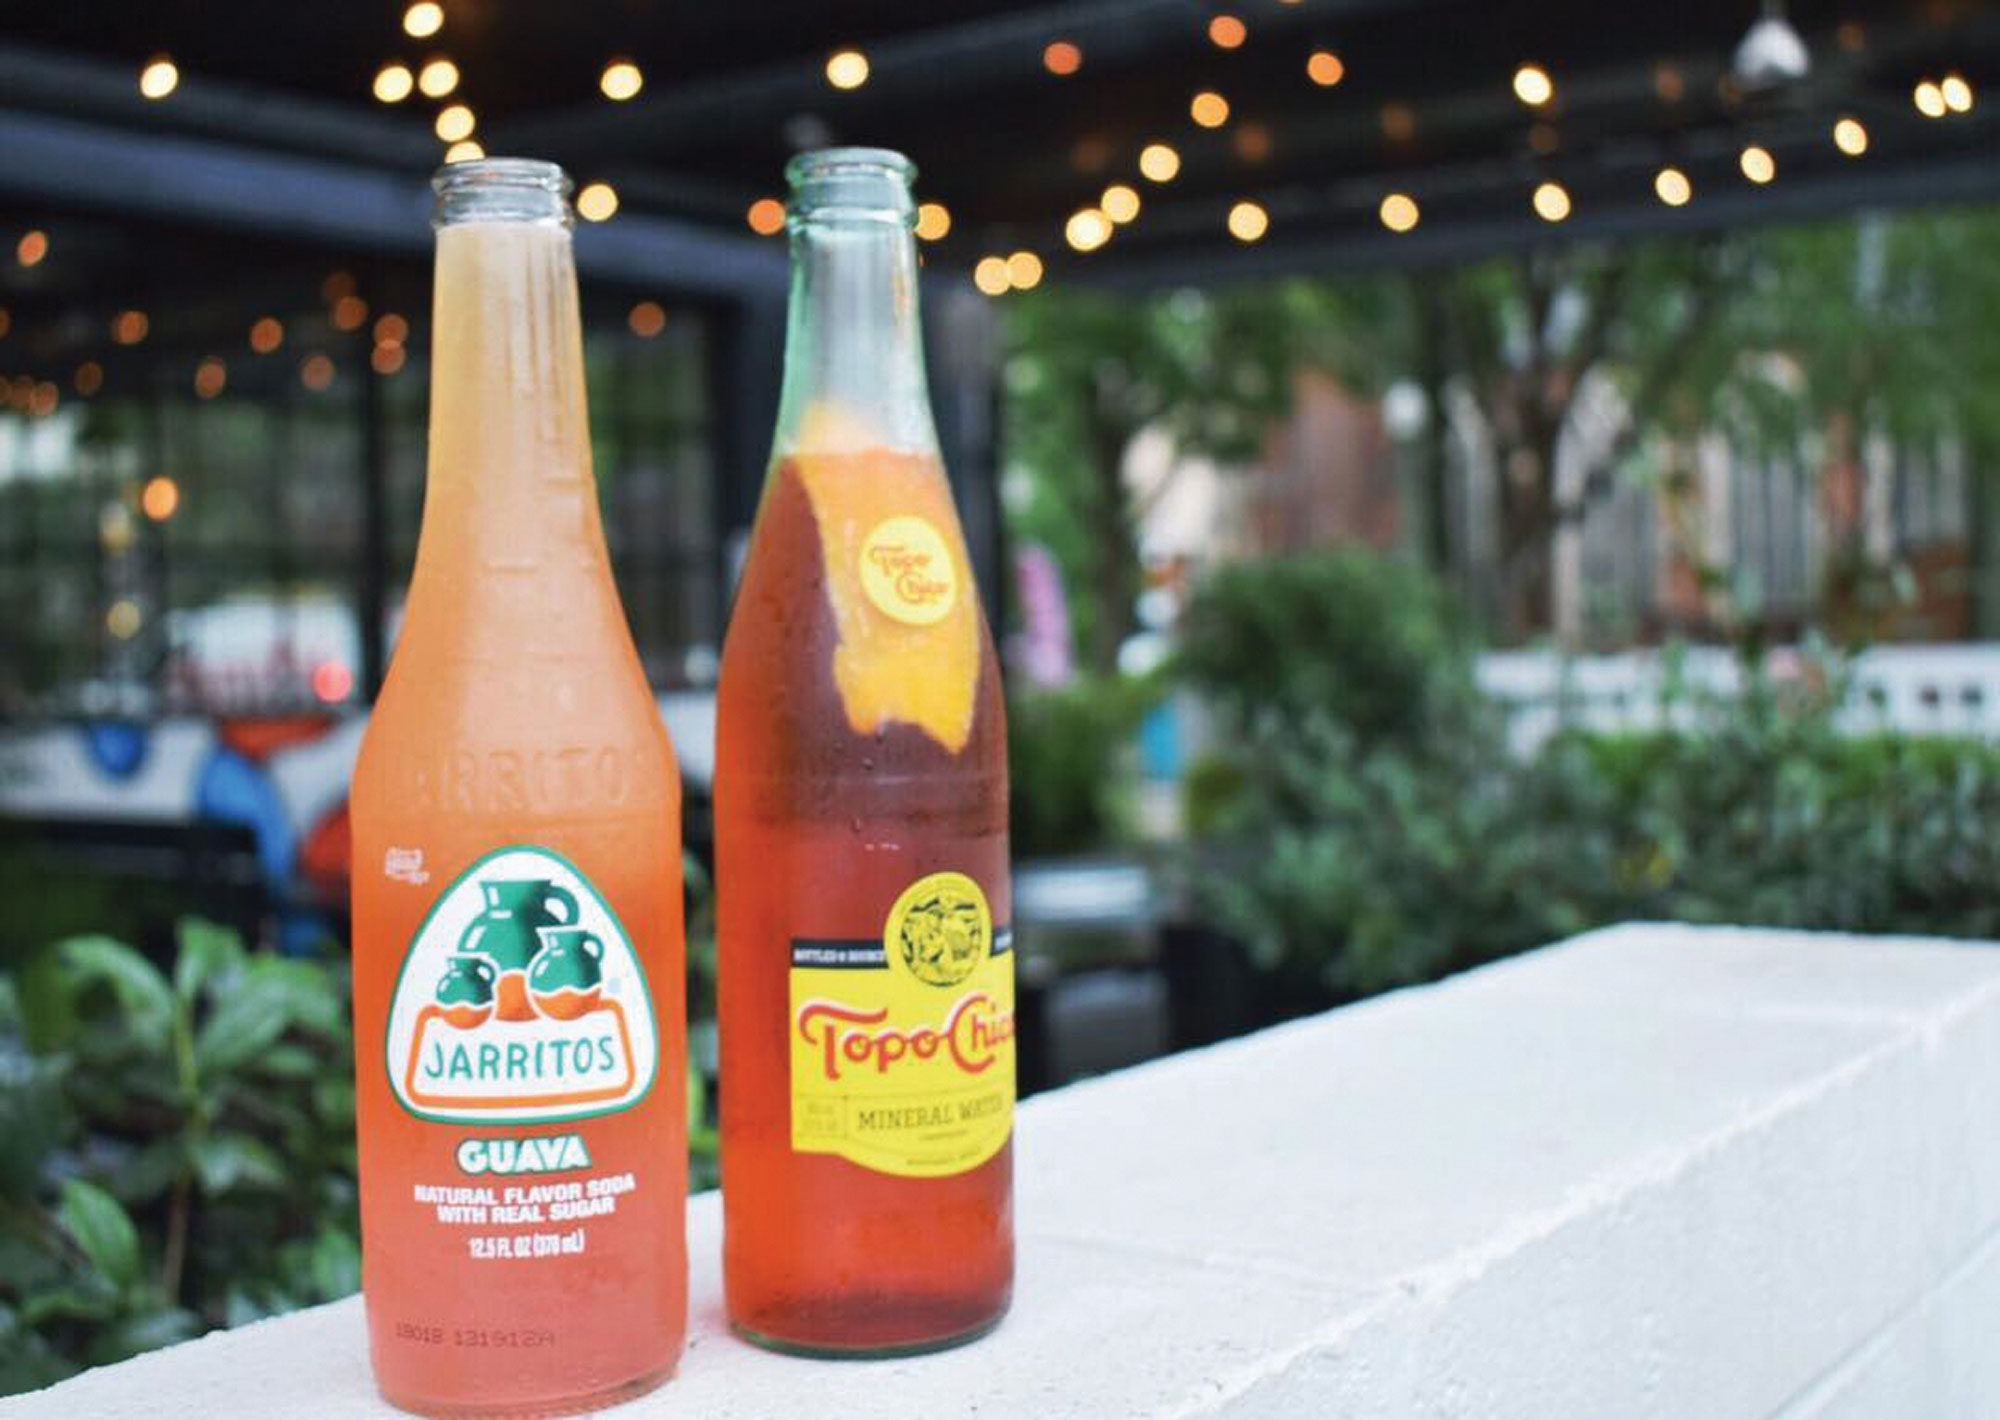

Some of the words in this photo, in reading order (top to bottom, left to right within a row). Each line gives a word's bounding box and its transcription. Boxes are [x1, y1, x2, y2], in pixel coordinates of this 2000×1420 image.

[424, 1035, 615, 1080] JARRITOS
[798, 1002, 941, 1081] Topo
[857, 1101, 955, 1132] MINERAL
[456, 1134, 593, 1175] GUAVA
[413, 1184, 499, 1205] NATURAL
[503, 1182, 582, 1205] FLAVOR
[585, 1173, 636, 1198] SODA
[437, 1204, 487, 1223] WITH
[491, 1203, 546, 1223] REAL
[549, 1196, 616, 1221] SUGAR
